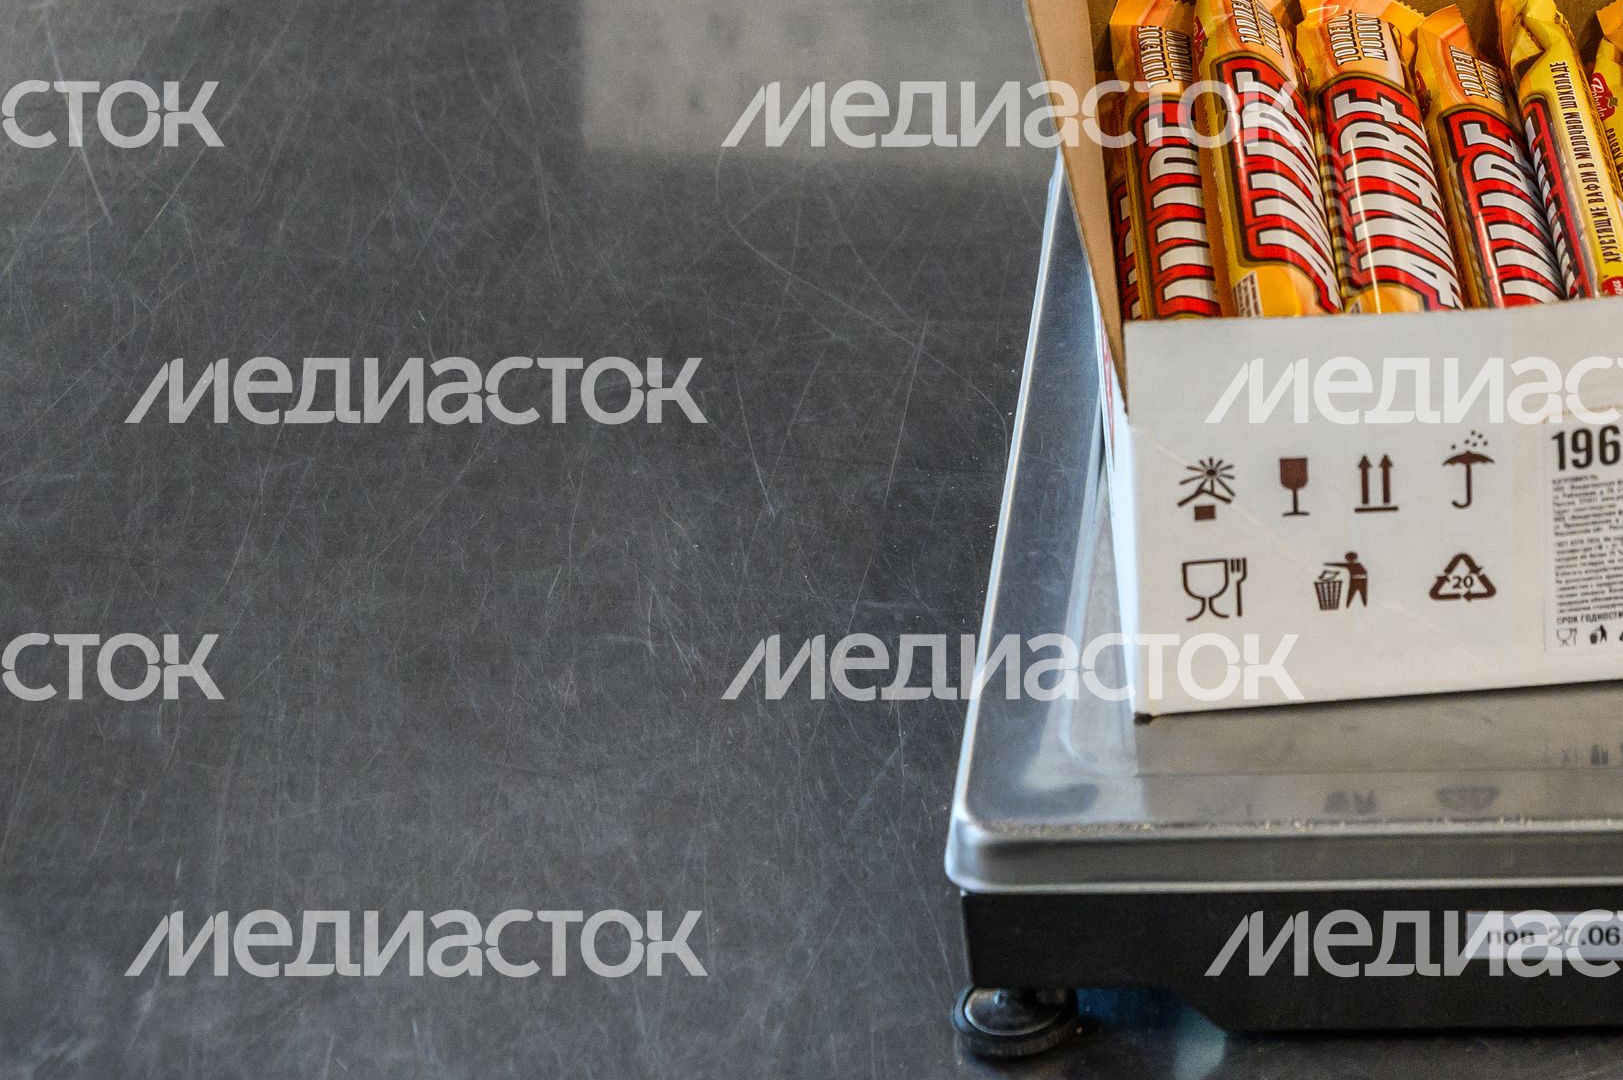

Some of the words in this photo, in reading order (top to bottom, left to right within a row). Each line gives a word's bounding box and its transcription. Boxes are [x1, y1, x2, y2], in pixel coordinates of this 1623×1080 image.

[1549, 61, 1577, 110] ШОКОЛАДЕ
[1564, 109, 1594, 160] МОЛОЧНОМ
[1334, 92, 1464, 311] AMARE
[1581, 169, 1606, 205] ВАФЛИ
[1590, 207, 1622, 264] ХРУСТЯЩИЕ
[1551, 424, 1622, 471] 196
[1453, 576, 1474, 589] 20
